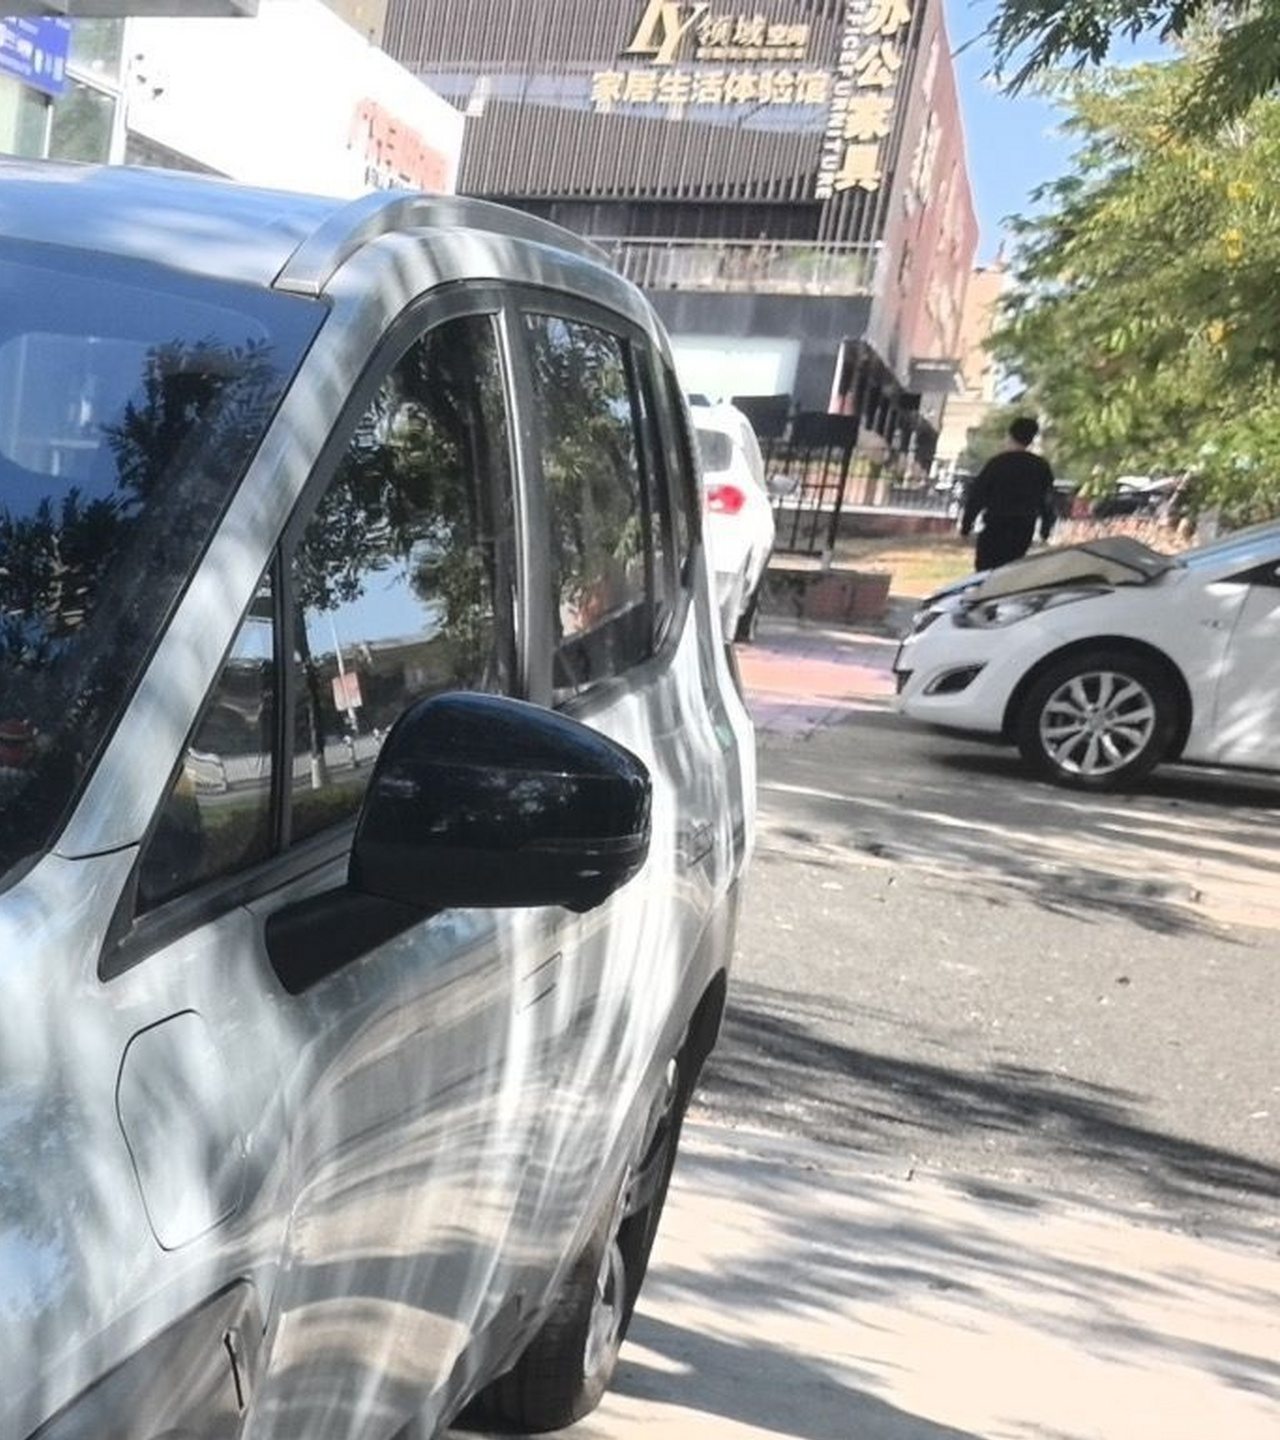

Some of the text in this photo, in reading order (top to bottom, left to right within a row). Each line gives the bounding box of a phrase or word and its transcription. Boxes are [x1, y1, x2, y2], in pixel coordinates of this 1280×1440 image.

[592, 70, 831, 103] 家居生活体验馆
